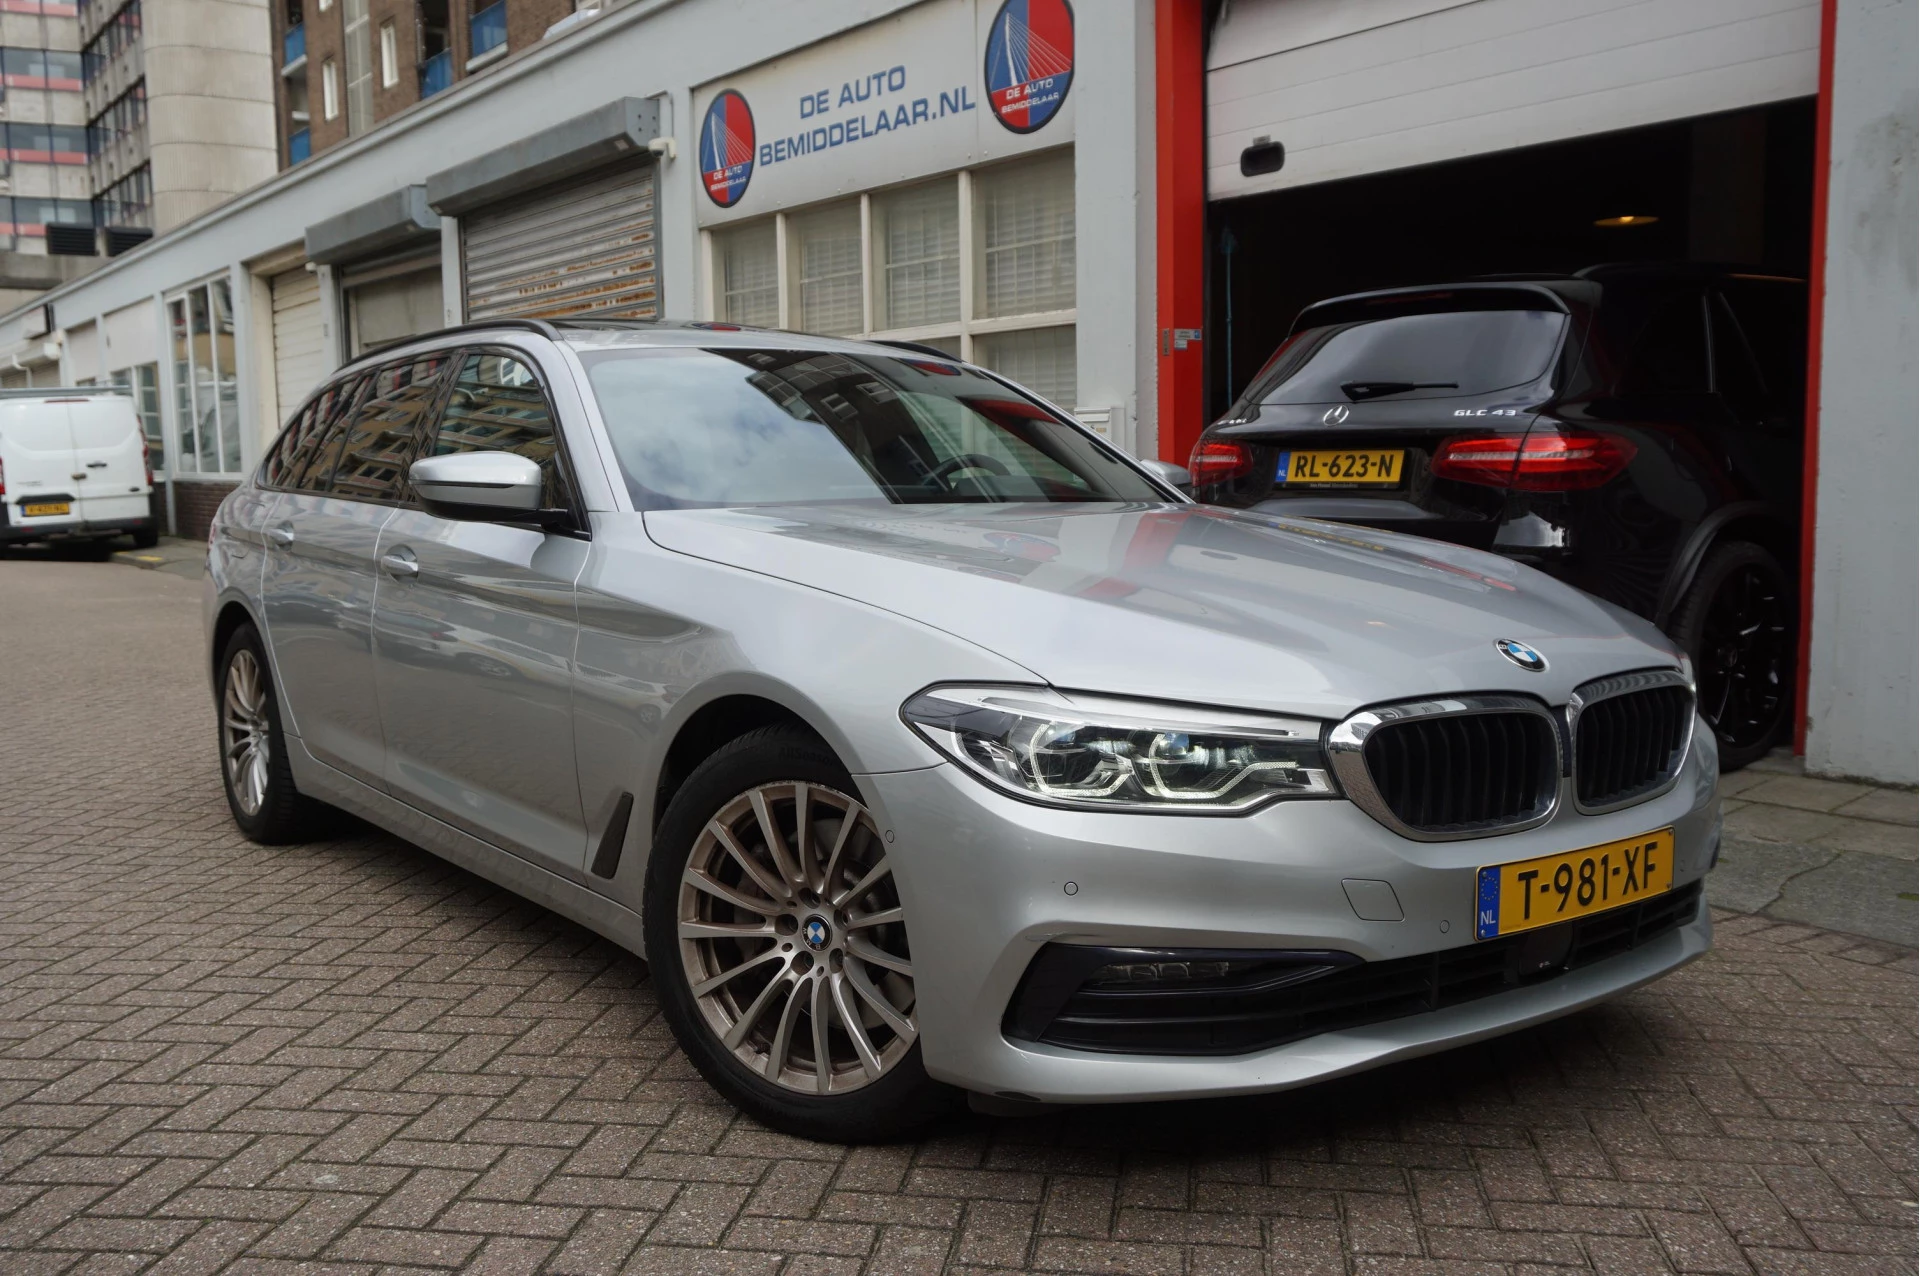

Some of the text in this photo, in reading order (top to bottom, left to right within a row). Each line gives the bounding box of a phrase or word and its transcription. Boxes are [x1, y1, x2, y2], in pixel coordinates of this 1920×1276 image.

[800, 65, 906, 120] DE AUTO
[1006, 78, 1054, 101] DE AUTO
[1001, 92, 1059, 114] BEMIDDELAAR
[759, 86, 976, 167] BEMIDDELAAR.NL
[710, 176, 747, 191] BEMIDDELAAR
[713, 165, 743, 181] DE AUTO
[1453, 409, 1517, 417] GLC 43
[1277, 469, 1287, 477] NL
[1294, 453, 1395, 478] RL-623-N
[1517, 841, 1659, 920] T-981-XF
[1480, 909, 1496, 926] NL
